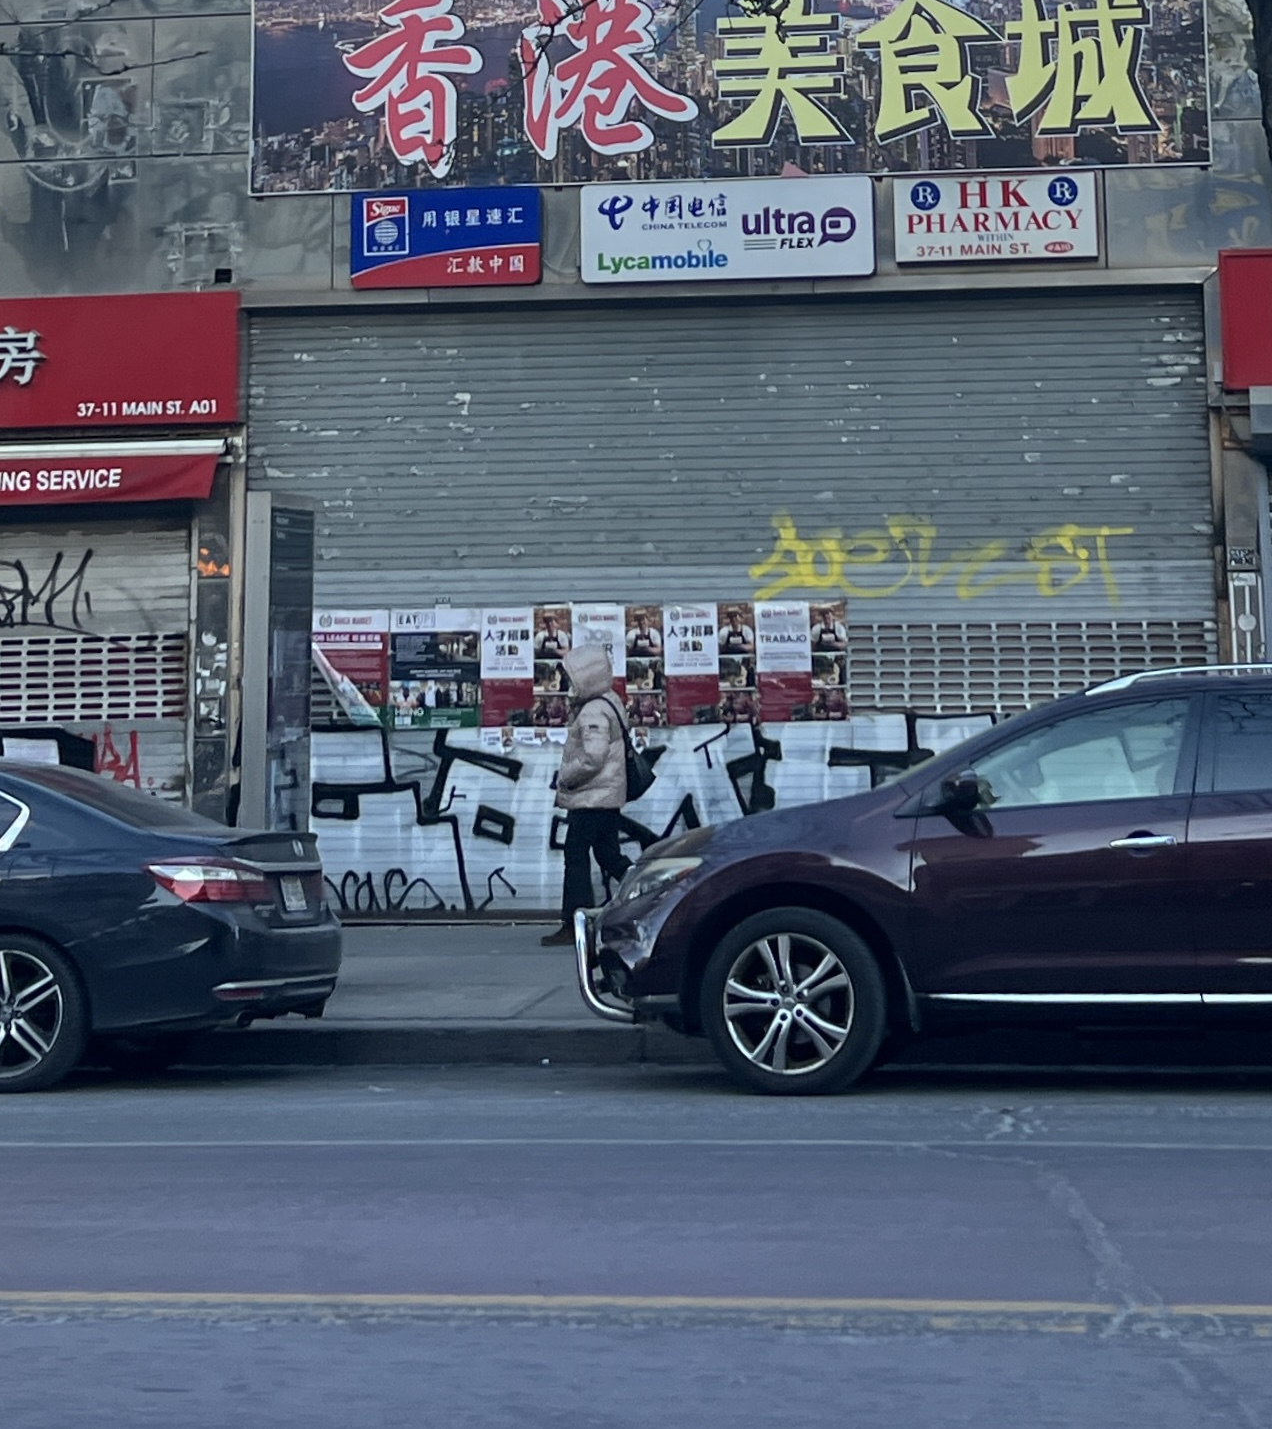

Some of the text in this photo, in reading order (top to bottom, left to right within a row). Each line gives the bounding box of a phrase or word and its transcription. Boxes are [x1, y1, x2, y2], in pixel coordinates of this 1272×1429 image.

[640, 193, 728, 220] 中国电信
[422, 207, 524, 228] 用银星速汇
[641, 221, 728, 231] CHINA TELECOM
[741, 206, 816, 236] ultra
[906, 209, 1084, 235] PHARMACY
[779, 237, 815, 250] FLEX
[976, 233, 1015, 243] WITHIN
[916, 242, 1032, 258] 37-11 MAIN ST.
[447, 254, 525, 274] 汇款中国
[597, 250, 728, 275] Lycamobile
[77, 399, 218, 417] 37-11 MAIN ST. A01
[35, 467, 123, 491] SERVICE
[326, 634, 349, 642] LEASE
[760, 634, 807, 644] TRABAJO
